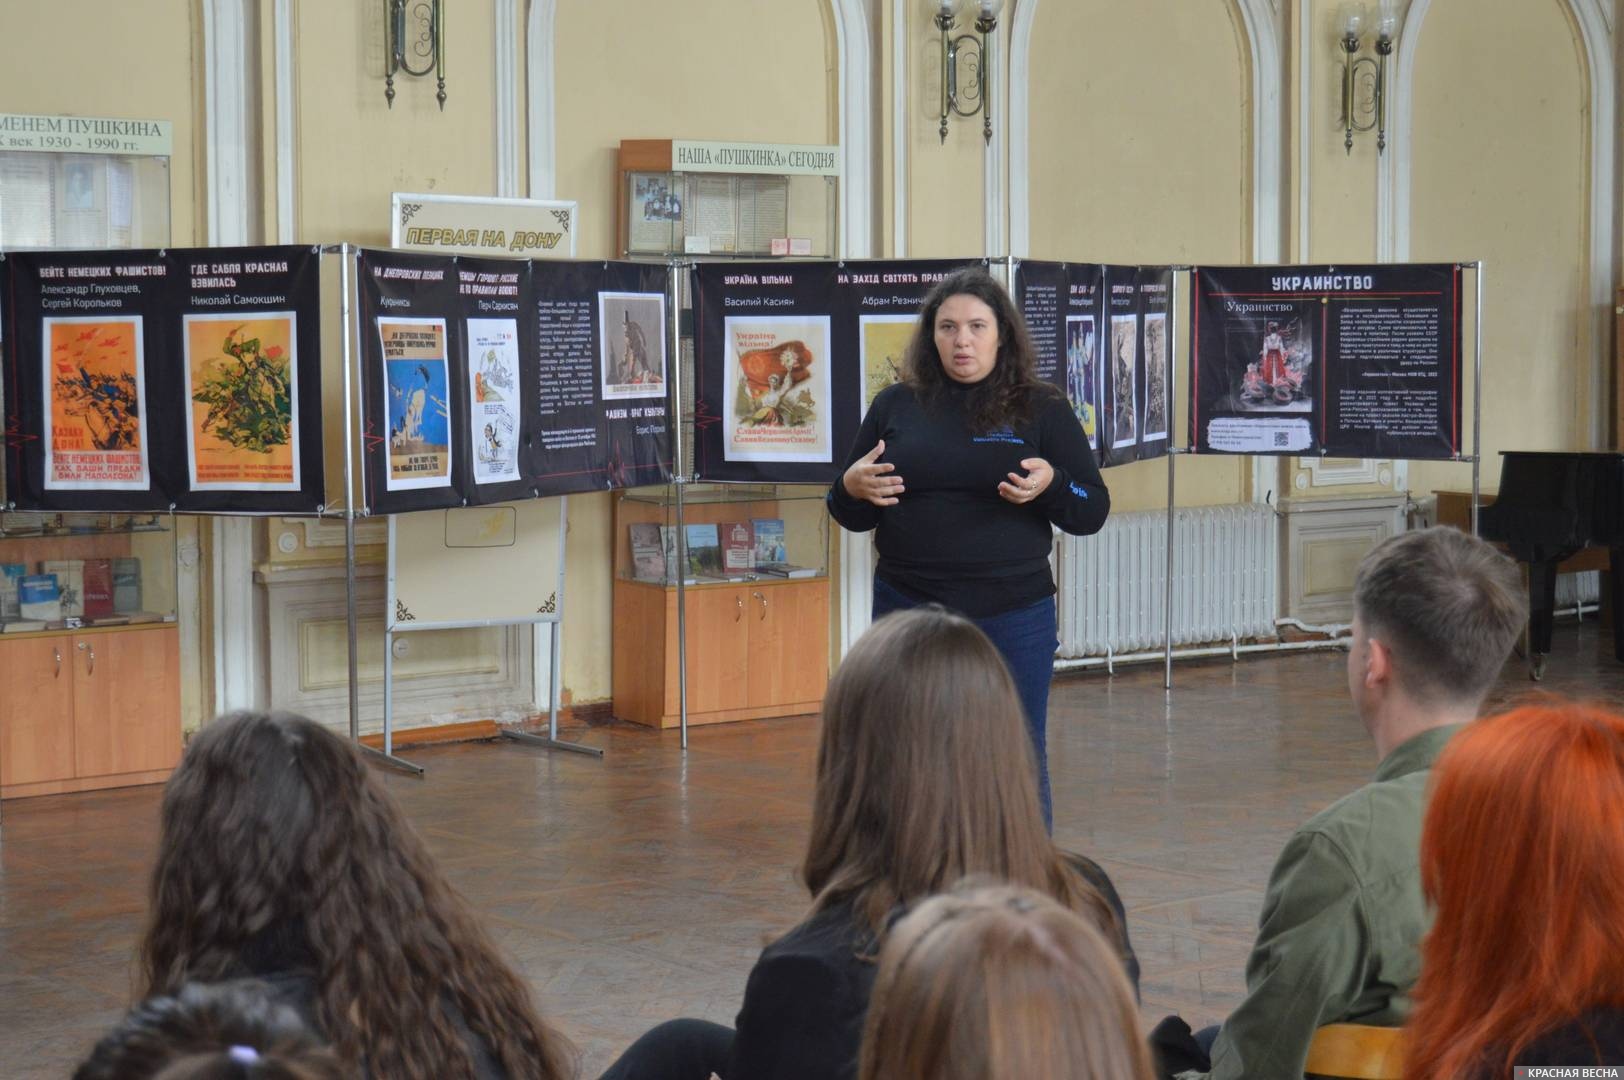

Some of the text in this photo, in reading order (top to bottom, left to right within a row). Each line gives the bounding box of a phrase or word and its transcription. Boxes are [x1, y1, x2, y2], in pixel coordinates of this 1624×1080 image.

[67, 118, 162, 137] ПУШКИНА
[39, 135, 72, 148] 1930
[87, 137, 120, 150] 1990
[678, 146, 835, 169] НАША «ПУШКИНКА» СЕГОДНЯ
[406, 227, 563, 252] ПЕРВАЯ НА ДОНУ
[39, 265, 167, 278] БЕЙТЕ НЕМЕЦКИХ ФАШИСТОВ!
[190, 262, 288, 275] ГДЕ САБЛЯ КРАСНАЯ
[191, 276, 237, 288] ВЗВИЛАСЬ
[724, 273, 794, 286] УКРАЇНА ВІЛЬНА!
[838, 275, 849, 284] НА
[852, 274, 880, 284] ЗАХІД
[883, 274, 918, 284] СВІТЯТЬ
[1272, 275, 1373, 291] УКРАИНСТВО
[41, 283, 142, 296] Александр Глуховцев,
[41, 297, 122, 309] Сергей Корольков
[191, 294, 286, 306] Николай Самокшин
[724, 296, 795, 307] Василий Касиян
[862, 296, 890, 307] Абрам
[1226, 301, 1293, 314] Украинство
